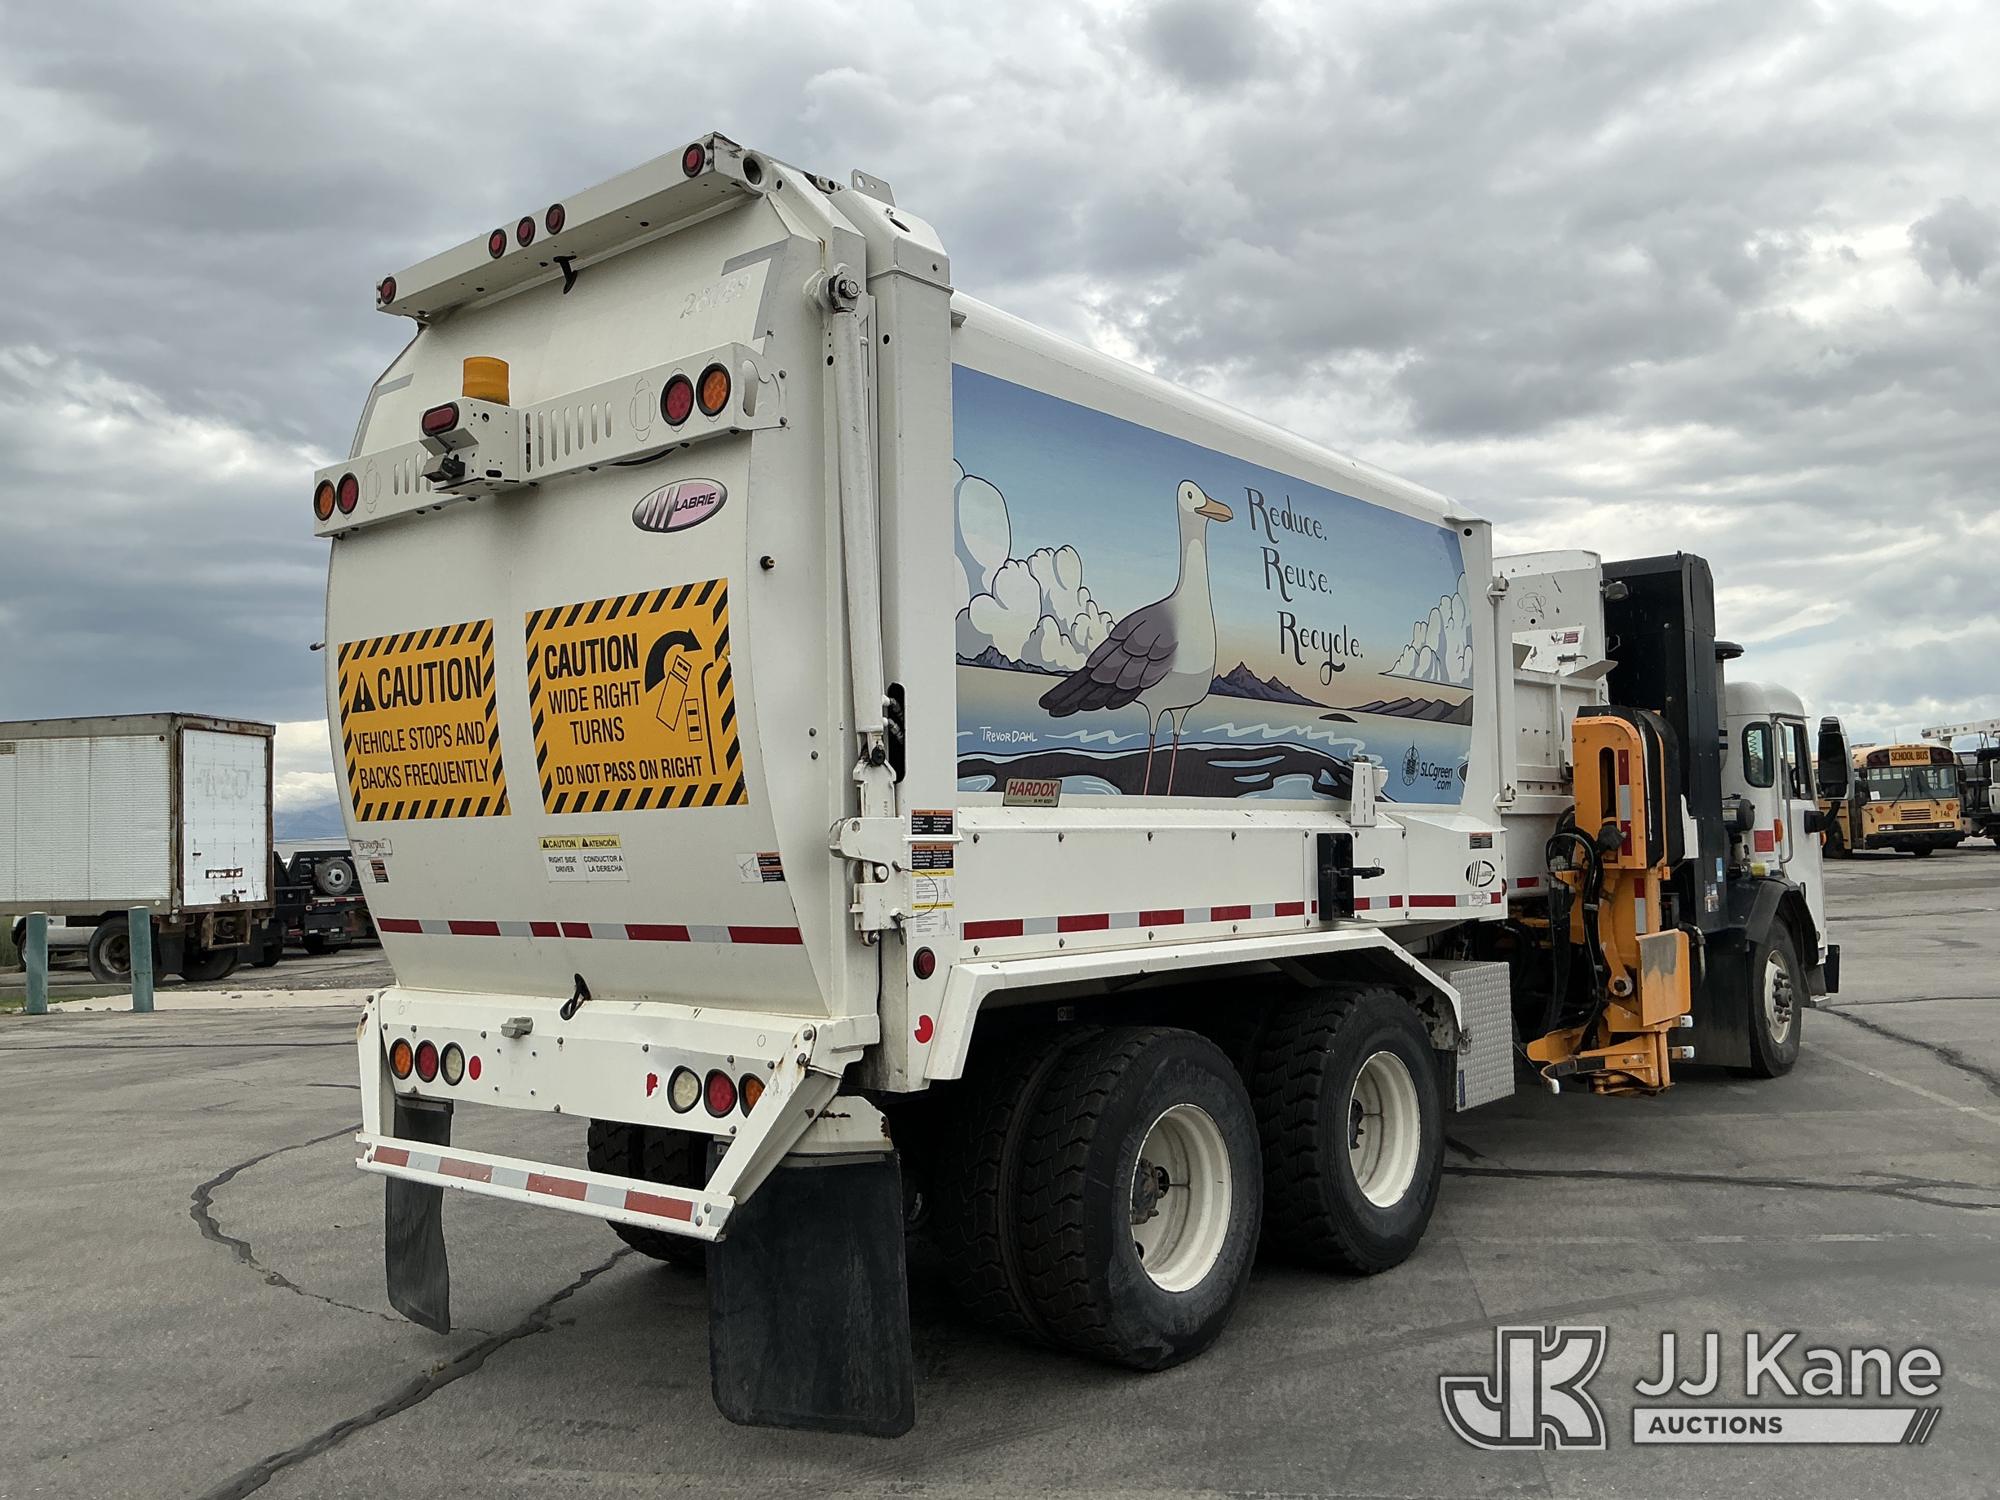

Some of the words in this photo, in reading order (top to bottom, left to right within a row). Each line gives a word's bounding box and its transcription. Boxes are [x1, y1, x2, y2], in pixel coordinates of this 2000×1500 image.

[675, 492, 717, 512] LABRIE
[1243, 487, 1328, 544] Reduce.
[1260, 546, 1333, 603] Reuse.
[544, 632, 639, 681] CAUTION
[1277, 611, 1364, 686] Recycle.
[377, 655, 483, 710] CAUTION
[548, 686, 589, 715] WIDE
[593, 680, 641, 710] RIGHT
[354, 728, 406, 755] VEHICLE
[408, 723, 453, 751] STOPS
[456, 721, 485, 747] AND
[569, 716, 625, 746] TURNS
[556, 765, 574, 785] DO
[576, 763, 601, 785] NOT
[603, 760, 637, 783] PASS
[639, 759, 659, 780] ON
[661, 756, 702, 779] RIGHT
[1891, 751, 1914, 761] SCHOOL
[1916, 751, 1929, 761] BUS
[360, 765, 402, 790] BACKS
[404, 758, 489, 787] FREQUENTLY
[1420, 762, 1453, 781] SLCgreen
[1008, 781, 1058, 797] HARDOX
[548, 839, 577, 849] CAUTION
[555, 865, 575, 873] DRIVER
[583, 855, 617, 863] CONDUCTOR
[618, 855, 624, 863] A
[588, 865, 596, 873] LA
[596, 865, 623, 873] DERECHA
